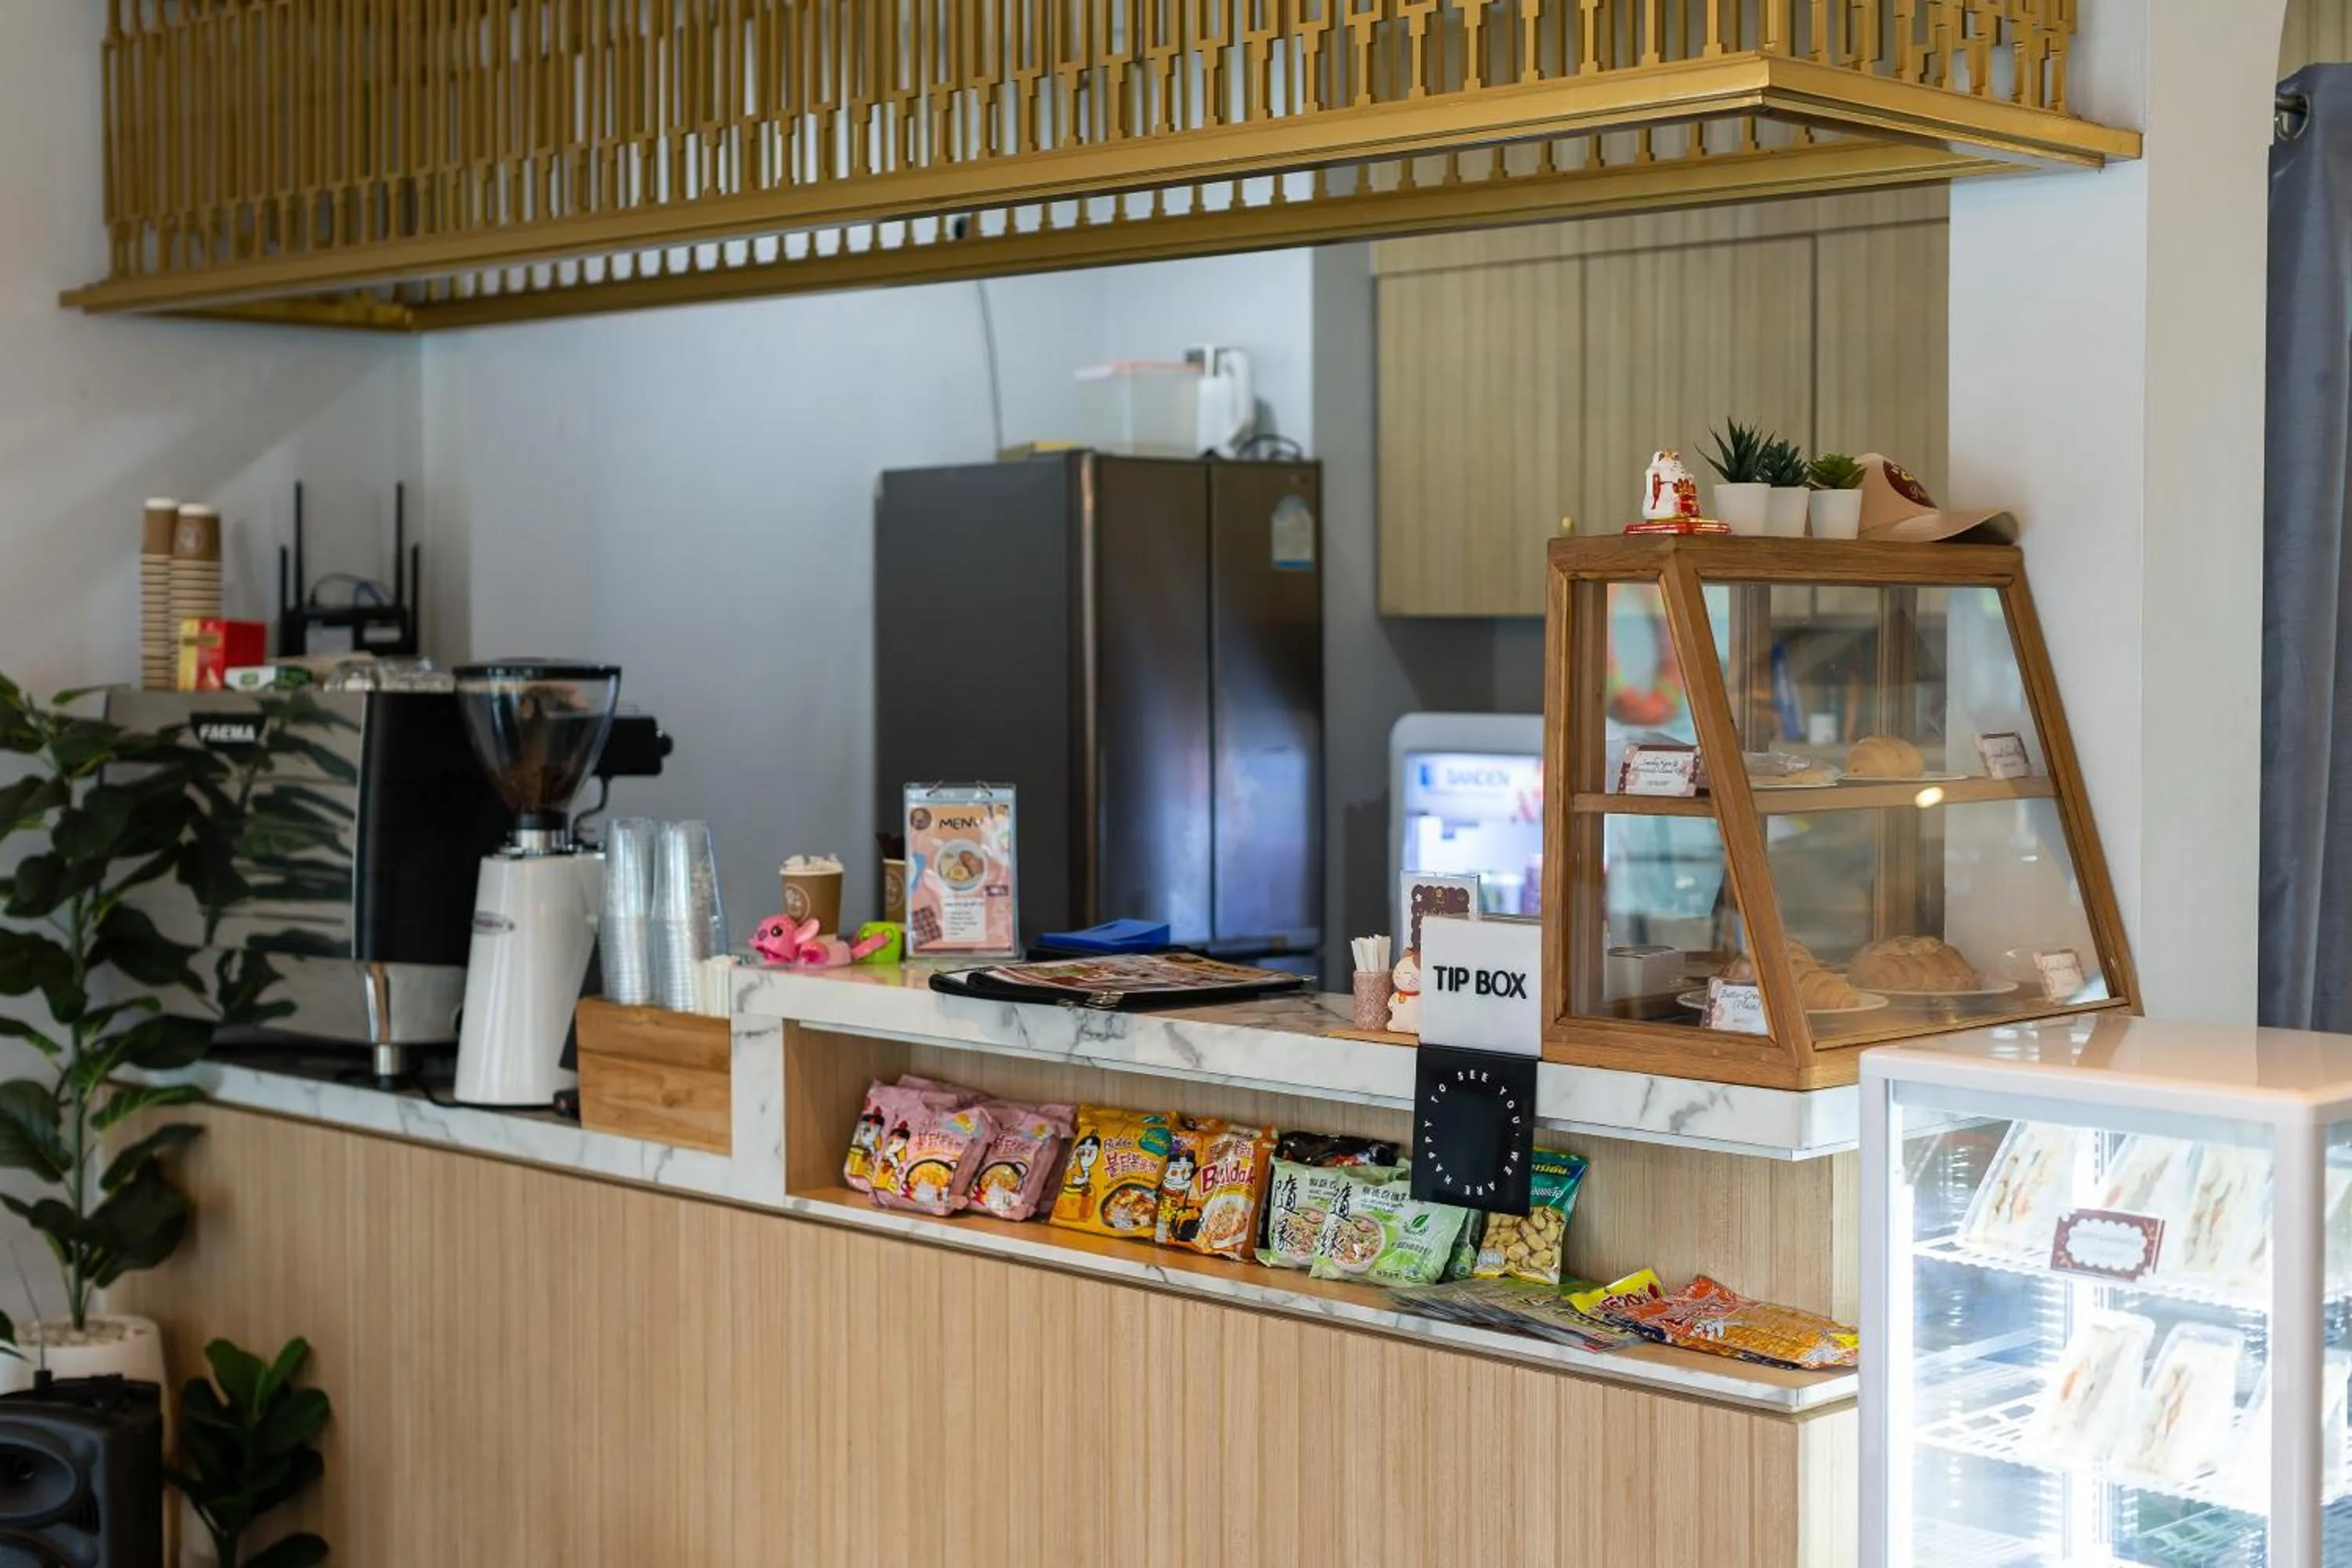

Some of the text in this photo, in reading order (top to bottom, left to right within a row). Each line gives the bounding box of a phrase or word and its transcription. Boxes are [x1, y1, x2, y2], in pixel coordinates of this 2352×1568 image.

[198, 722, 256, 742] FAEMA
[1432, 965, 1527, 1000] TIP BOX
[1457, 1069, 1489, 1083] SEE
[1431, 1083, 1446, 1103] TO
[1424, 1120, 1453, 1185] HAPPY
[1465, 1181, 1496, 1196] ARE
